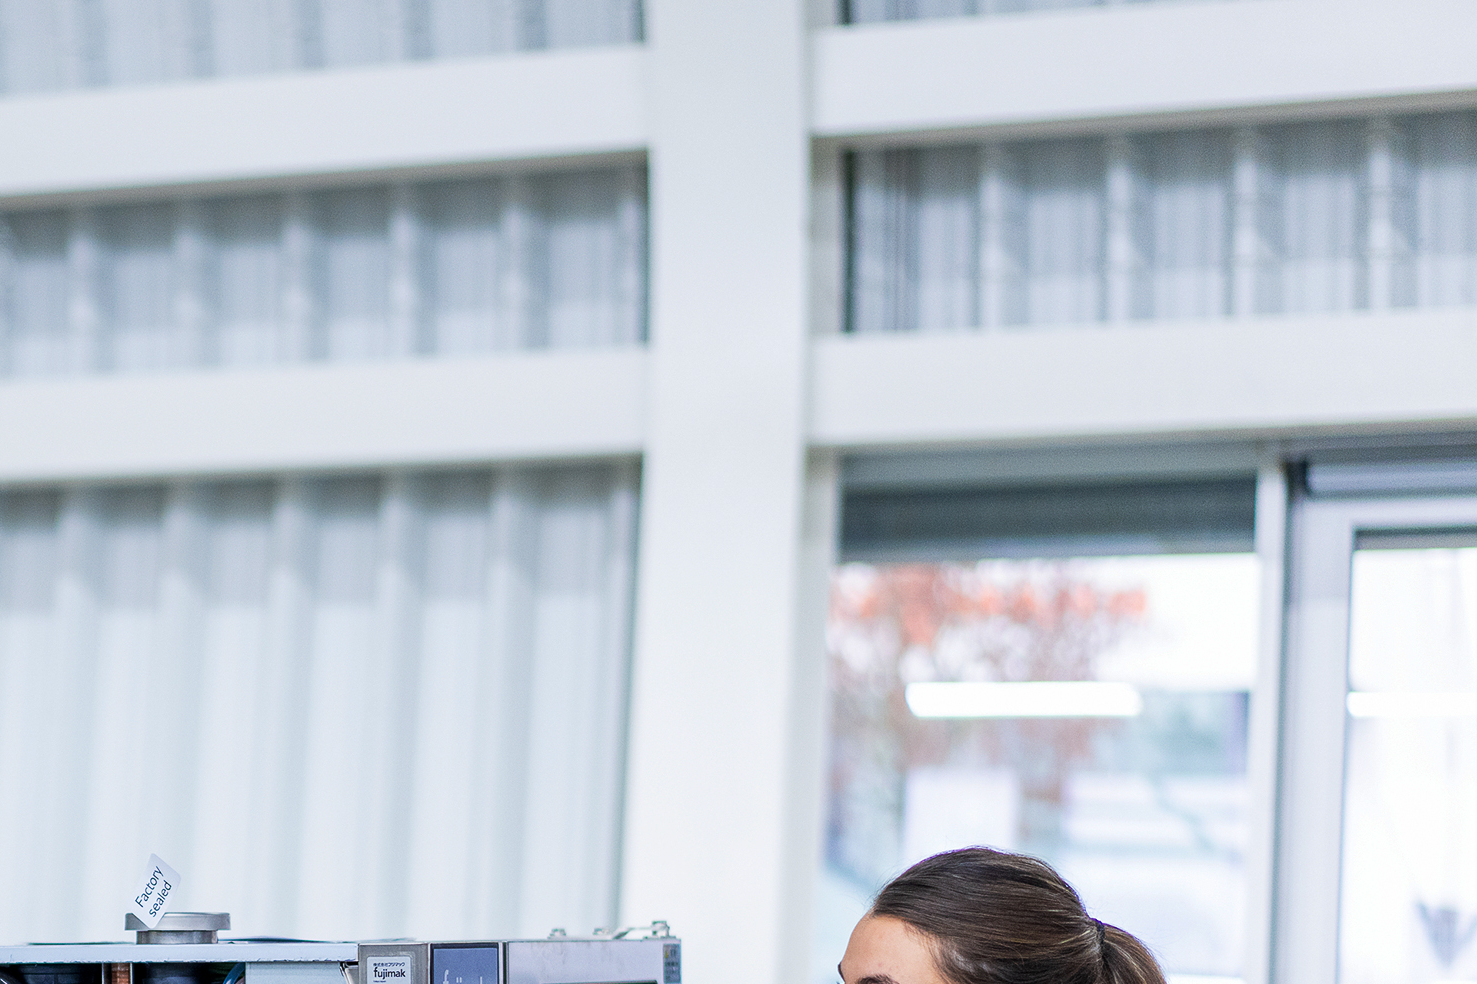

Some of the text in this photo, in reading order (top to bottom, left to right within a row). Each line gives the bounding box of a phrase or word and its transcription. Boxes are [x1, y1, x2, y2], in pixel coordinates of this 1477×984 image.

[135, 865, 164, 908] Factory
[148, 879, 172, 918] sealed
[373, 966, 406, 980] fujimak
